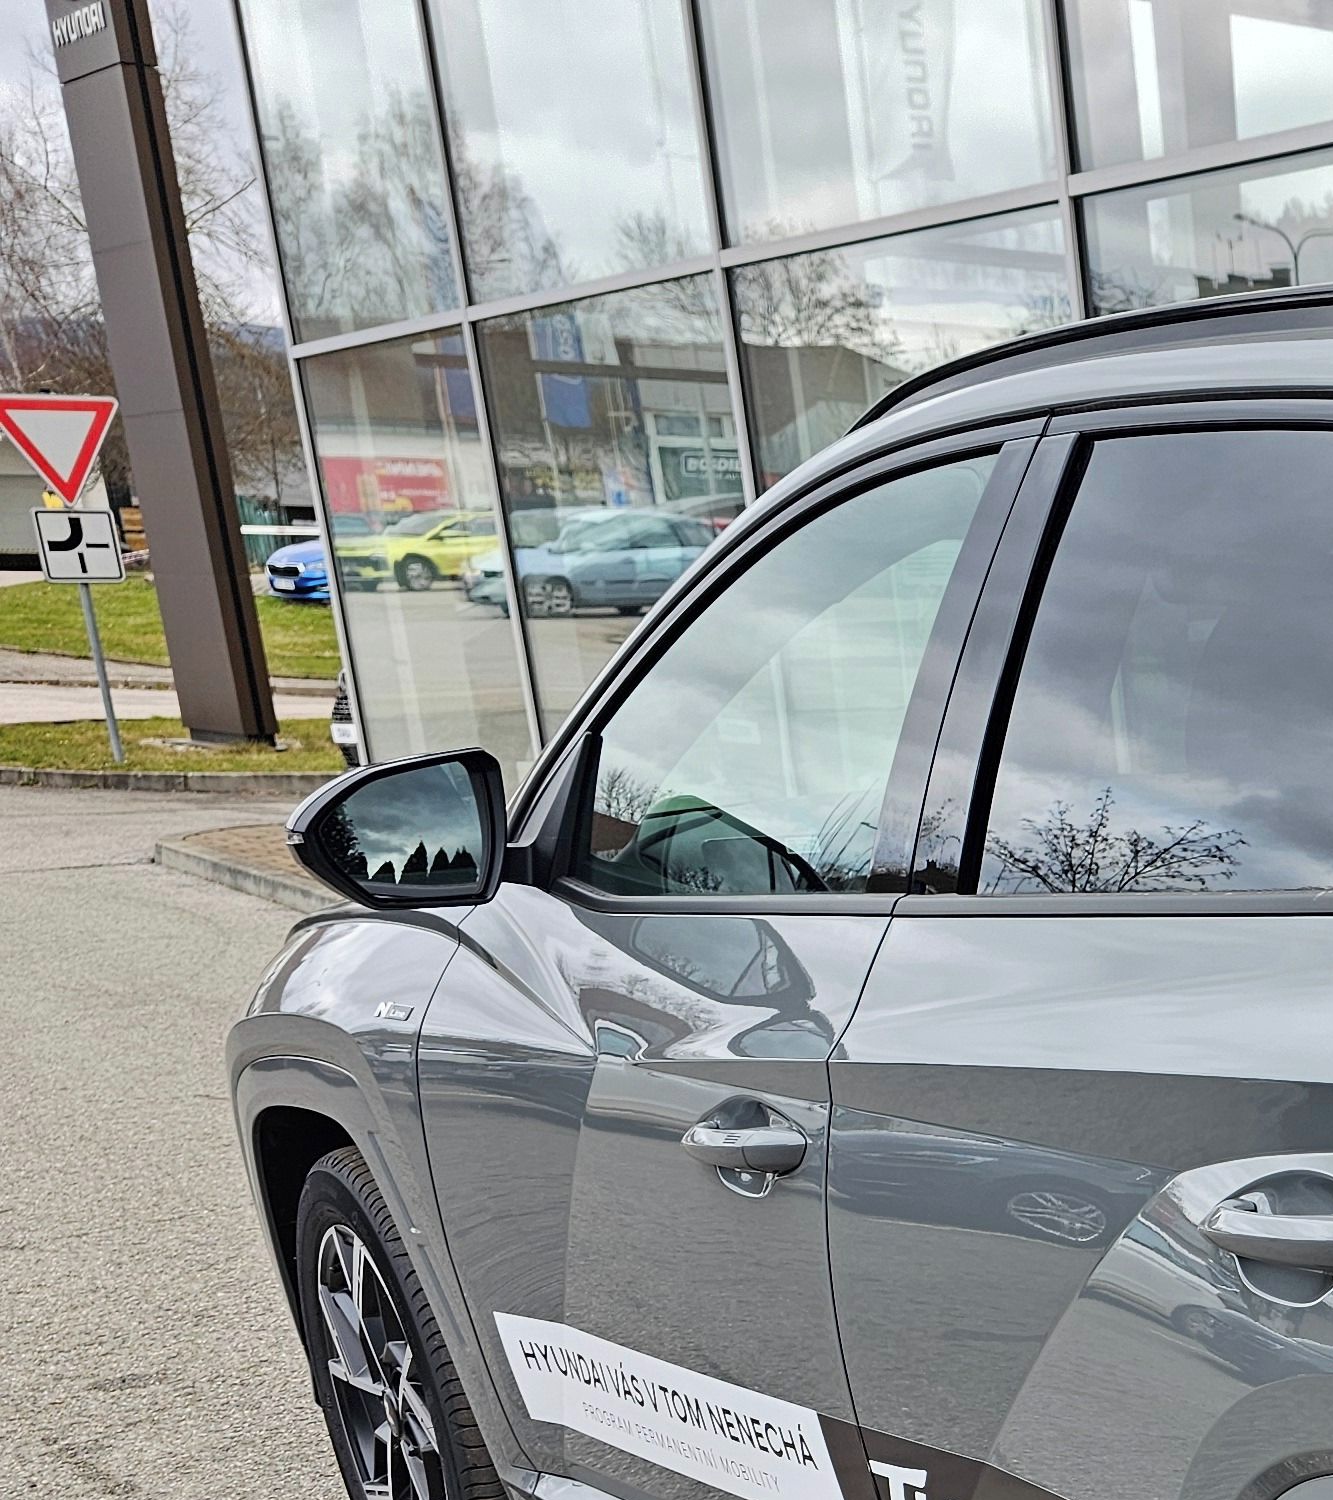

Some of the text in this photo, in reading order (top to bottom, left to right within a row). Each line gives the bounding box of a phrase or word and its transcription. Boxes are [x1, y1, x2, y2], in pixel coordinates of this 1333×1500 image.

[52, 1, 106, 48] HYUNDAI
[518, 1339, 820, 1471] HYUNDAI VÁS V TOM NENECHÁ
[582, 1401, 781, 1494] PROGRAM PERMANENTNÍ MOBILITY
